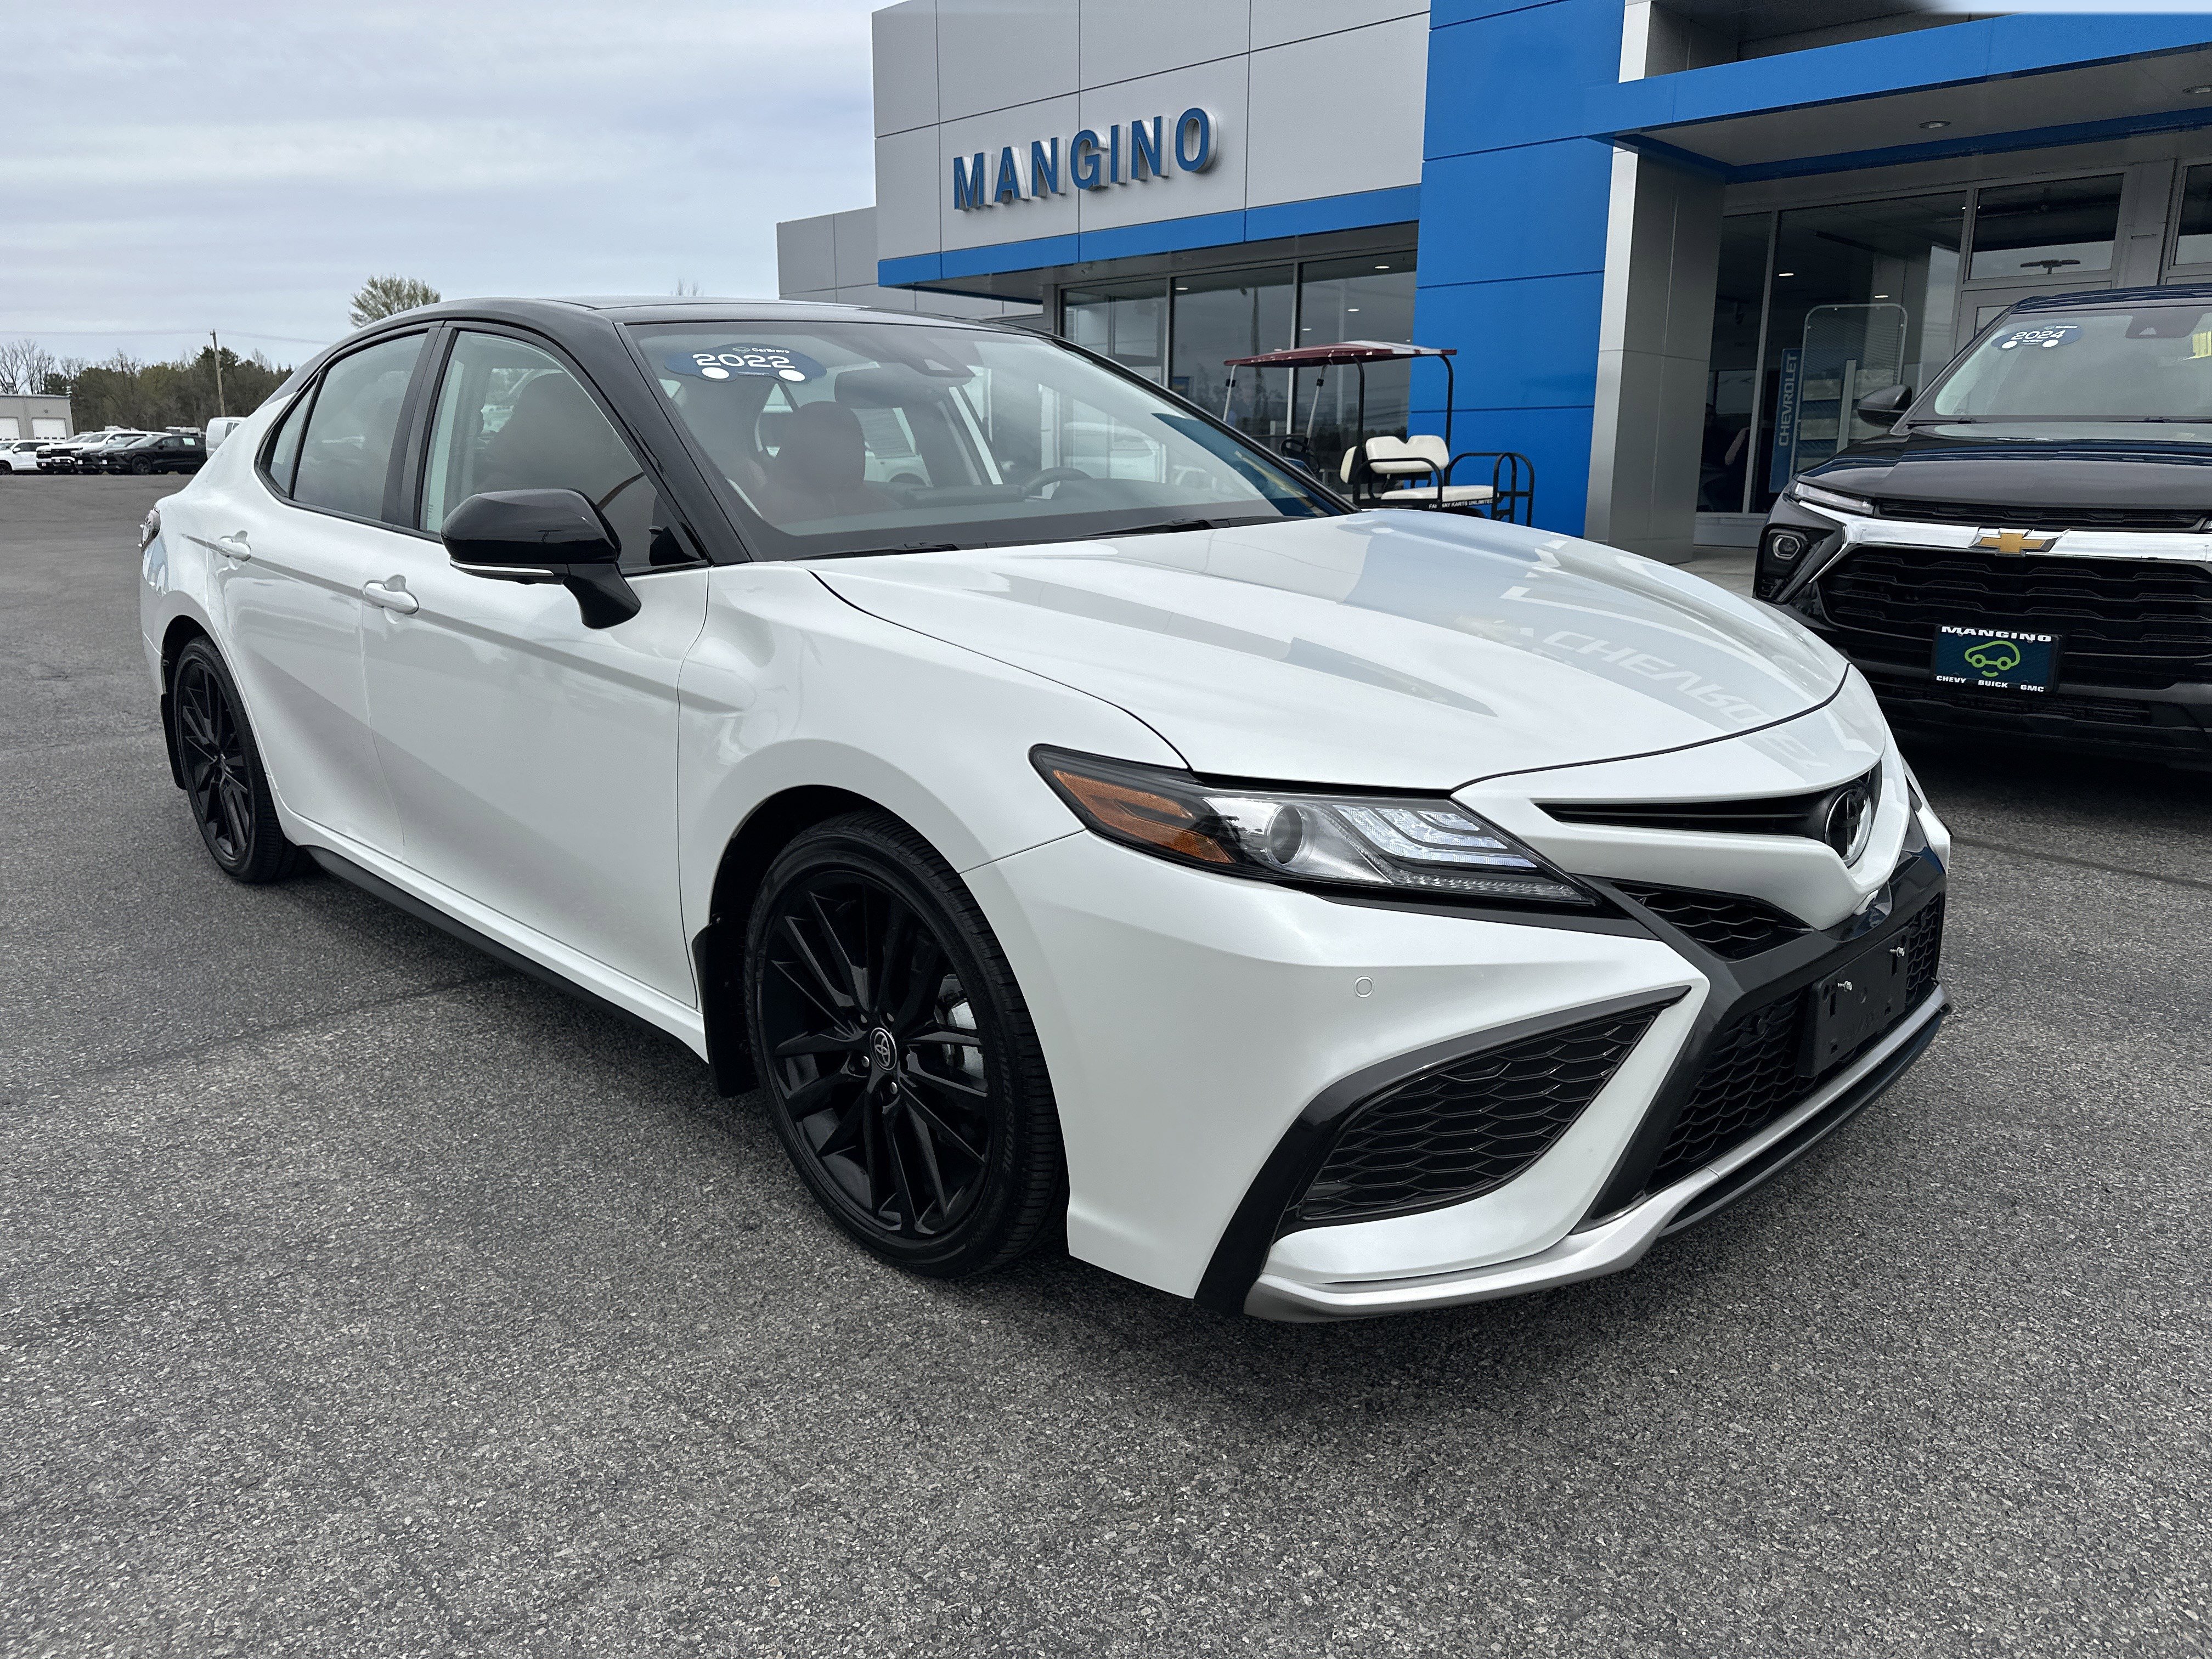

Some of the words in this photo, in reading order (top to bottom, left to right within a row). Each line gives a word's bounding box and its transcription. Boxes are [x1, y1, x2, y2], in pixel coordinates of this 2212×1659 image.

[953, 107, 1217, 211] MANGINO
[2011, 330, 2066, 340] 2024
[692, 353, 795, 369] 2022
[1779, 353, 1798, 447] CHEVROLET
[1941, 626, 2052, 642] MANGINO
[1936, 675, 1966, 684] CHEVY
[1978, 680, 2008, 688] BUICK
[2020, 684, 2044, 692] GMC
